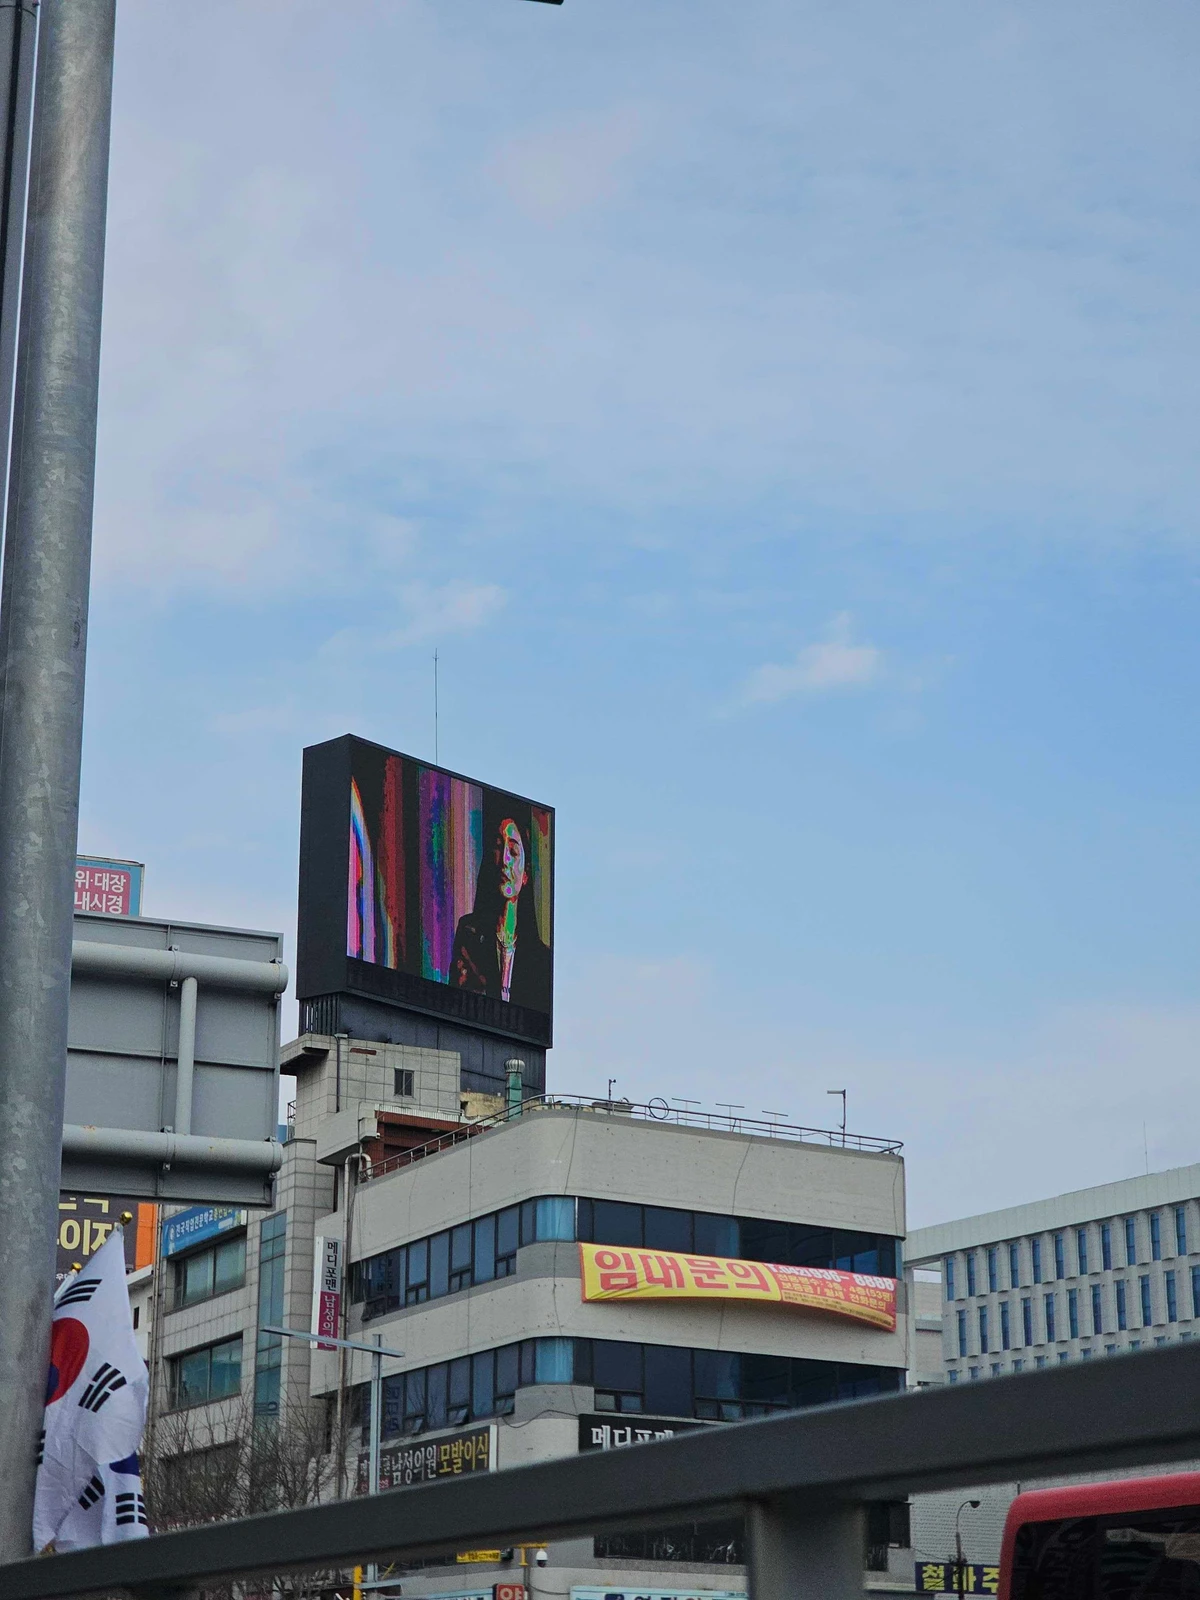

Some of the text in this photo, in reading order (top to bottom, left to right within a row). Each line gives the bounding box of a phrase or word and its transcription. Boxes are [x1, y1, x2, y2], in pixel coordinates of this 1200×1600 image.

[74, 870, 126, 893] 위·대장
[73, 891, 123, 914] 내시경
[325, 1241, 339, 1292] 메디포맨
[594, 1250, 771, 1293] 임대문의
[850, 1293, 887, 1311] 전화문의
[391, 1444, 437, 1486] 남성의원
[440, 1432, 489, 1474] 모발이식
